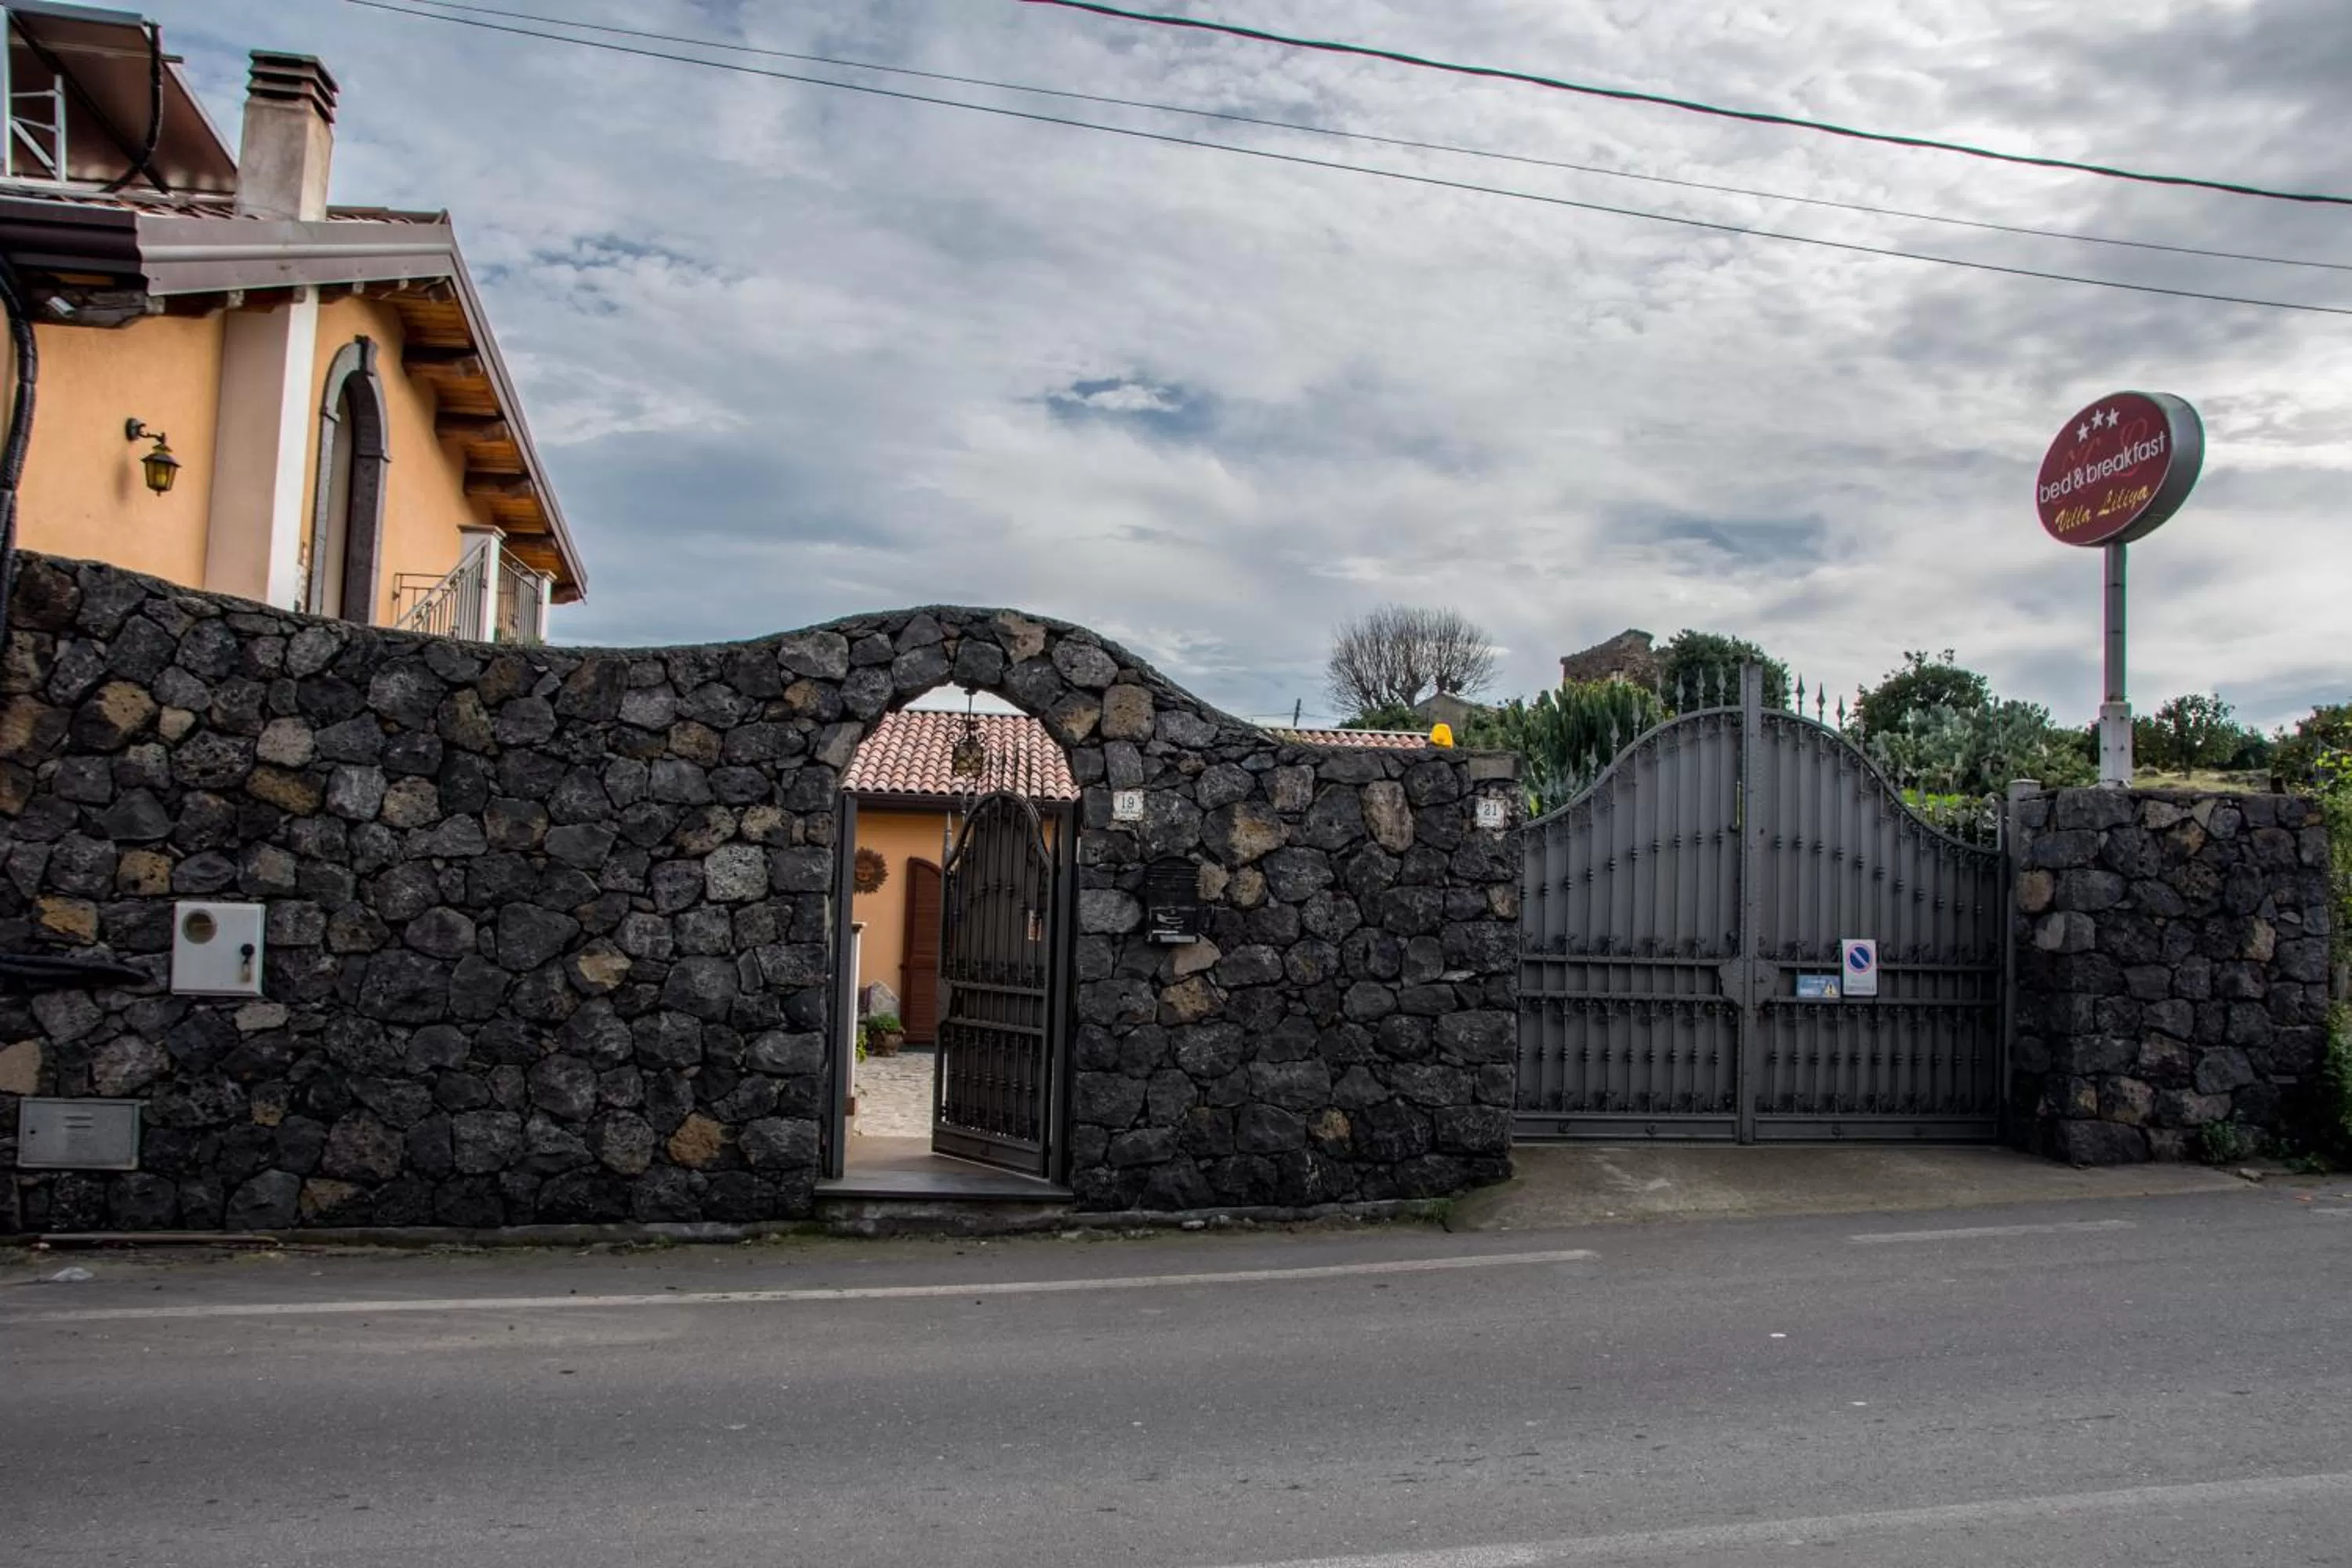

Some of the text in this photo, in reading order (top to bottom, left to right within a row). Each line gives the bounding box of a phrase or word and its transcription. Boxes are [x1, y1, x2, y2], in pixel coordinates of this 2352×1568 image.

[2055, 505, 2091, 533] Villa
[1121, 796, 1135, 809] 19
[1483, 804, 1497, 816] 21
